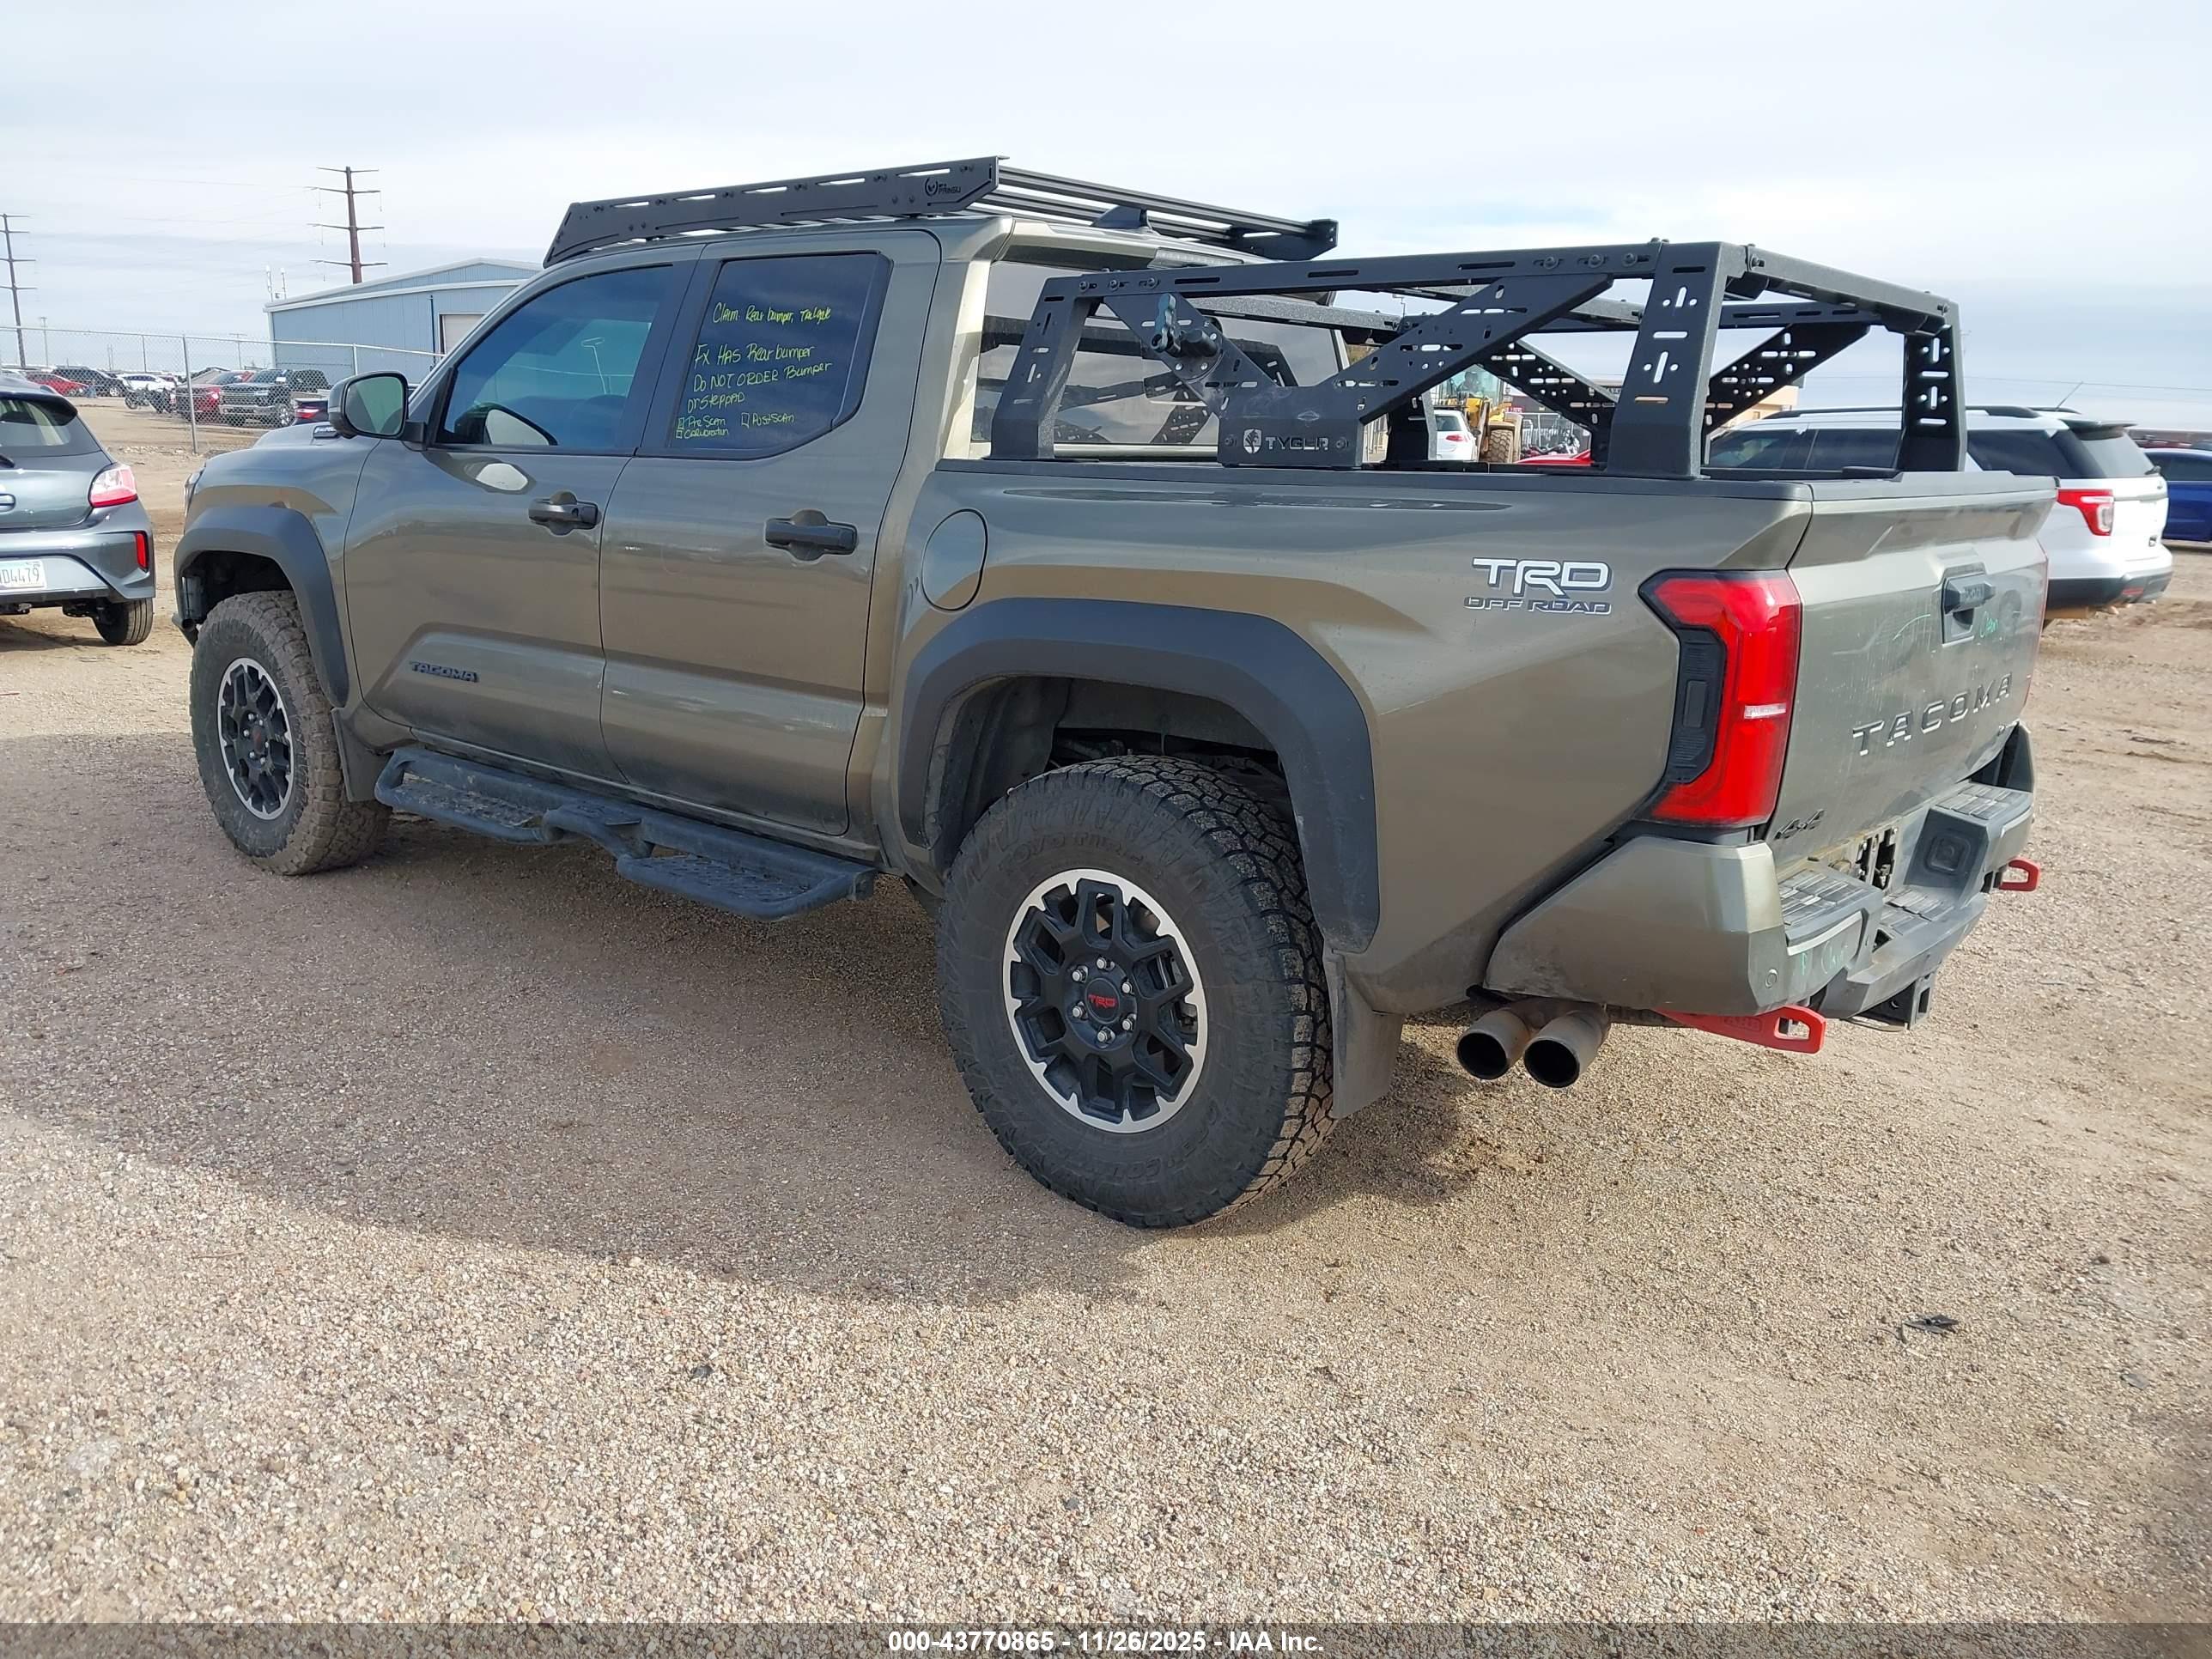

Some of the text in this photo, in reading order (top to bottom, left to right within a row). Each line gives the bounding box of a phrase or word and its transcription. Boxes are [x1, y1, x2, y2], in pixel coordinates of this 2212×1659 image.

[710, 372, 736, 390] NOT
[737, 369, 779, 386] ORDER
[0, 568, 40, 584] D4479
[1473, 557, 1613, 599] TRD
[1464, 596, 1612, 615] OFF ROAD
[410, 660, 480, 684] TACOMA
[1852, 672, 2013, 757] TACOMA
[1087, 994, 1116, 1009] TRD
